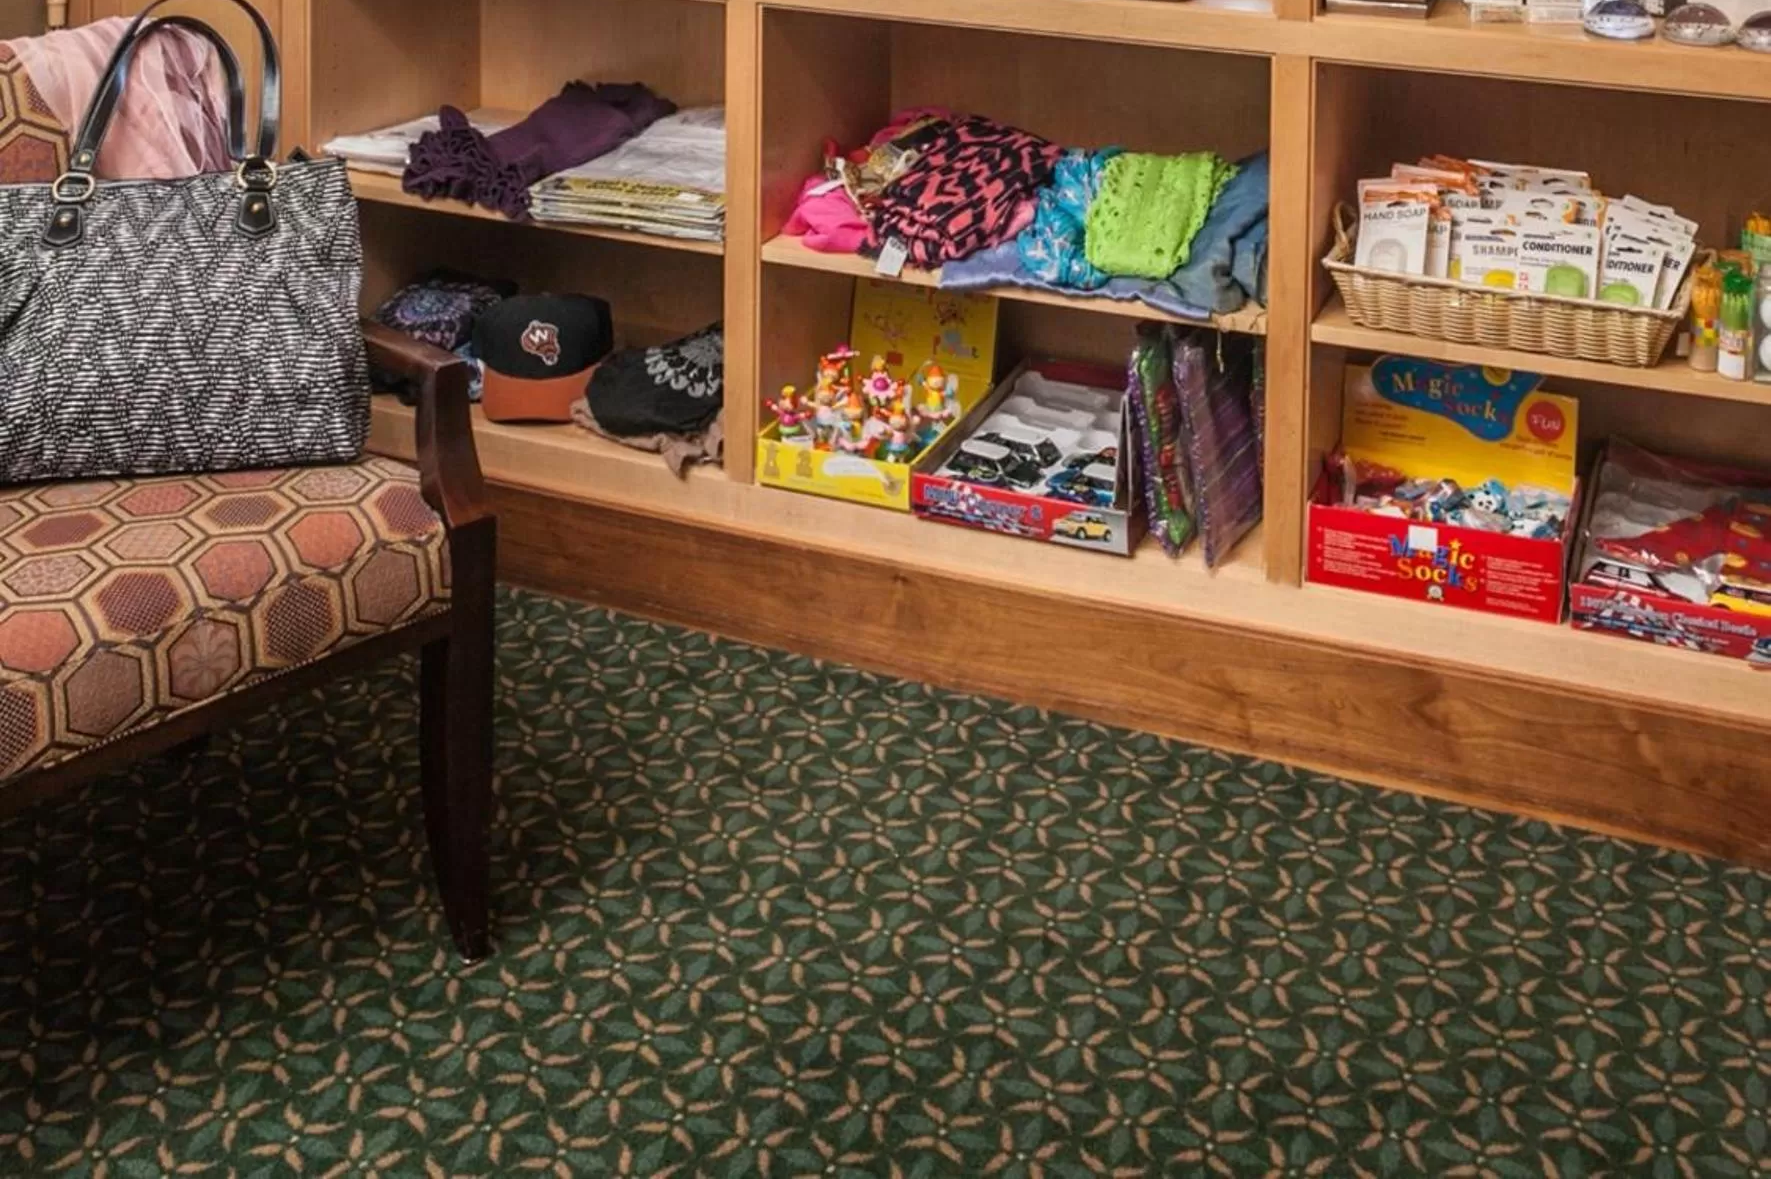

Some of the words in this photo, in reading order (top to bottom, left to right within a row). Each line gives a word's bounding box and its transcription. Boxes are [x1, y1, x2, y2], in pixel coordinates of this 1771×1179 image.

[1364, 211, 1394, 221] HAND
[1396, 208, 1426, 219] SOAP
[1522, 240, 1593, 256] CONDITIONER
[1605, 259, 1655, 274] DITIONER
[529, 329, 548, 344] W
[1397, 557, 1478, 593] Socks
